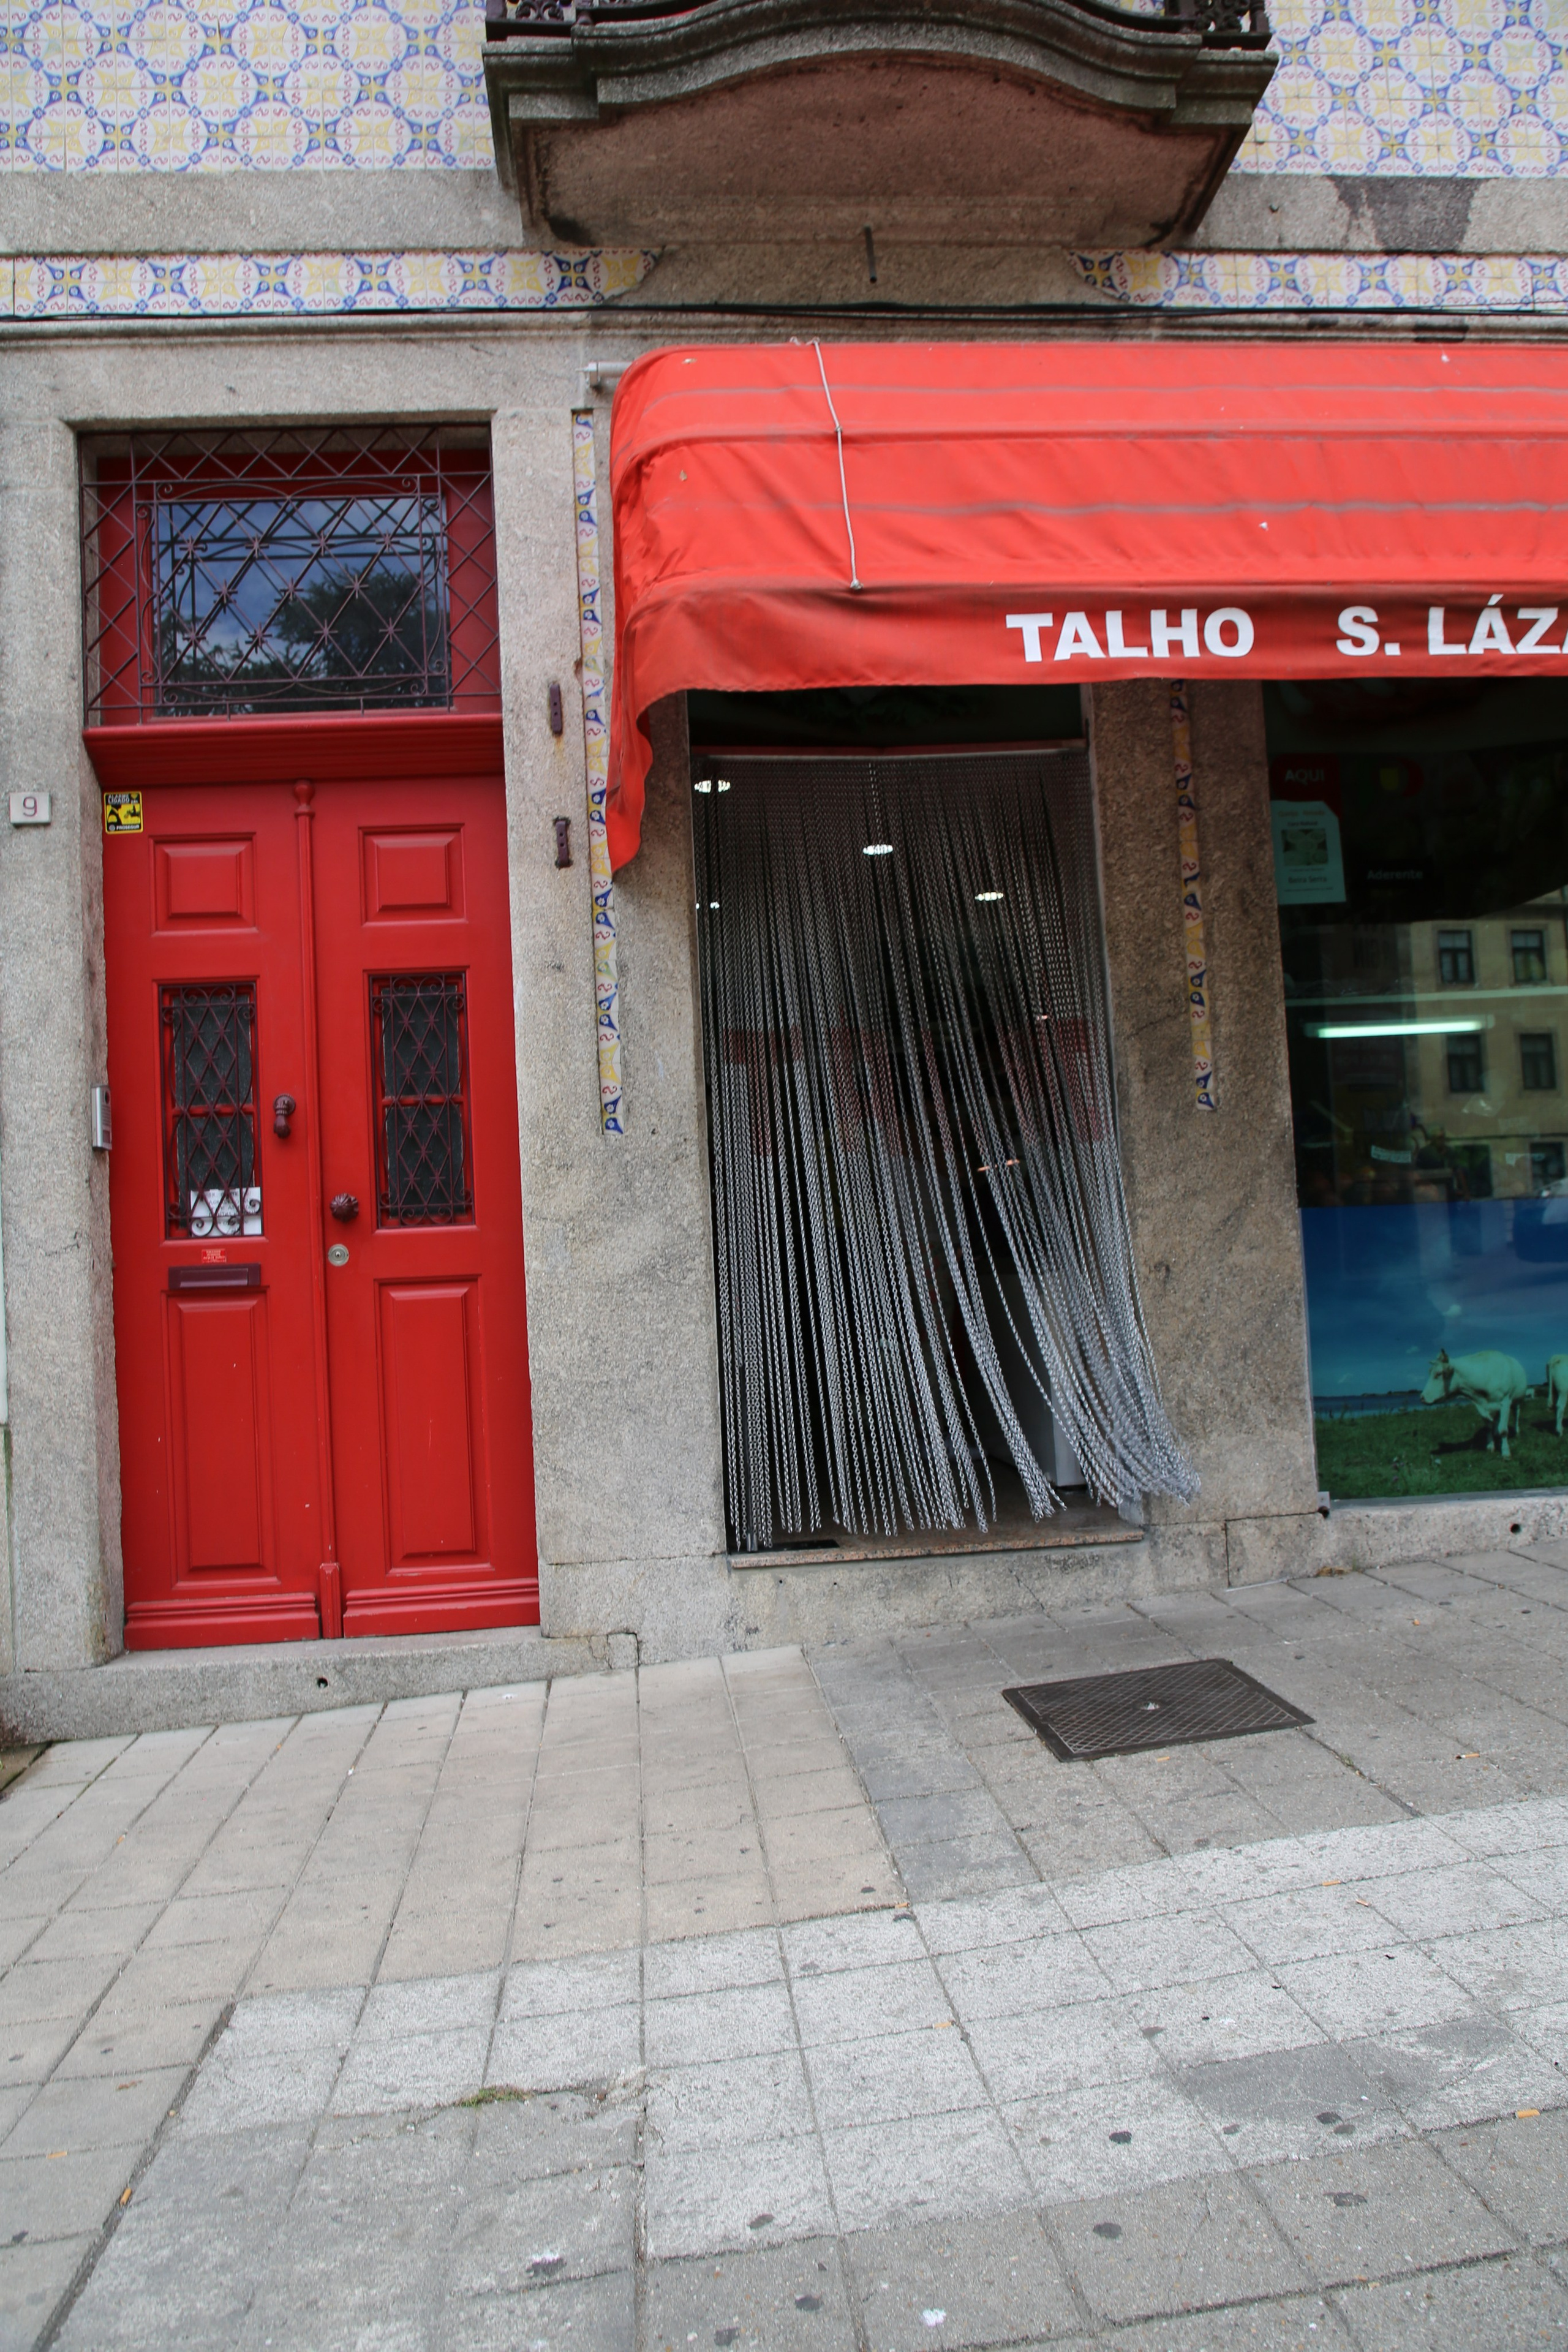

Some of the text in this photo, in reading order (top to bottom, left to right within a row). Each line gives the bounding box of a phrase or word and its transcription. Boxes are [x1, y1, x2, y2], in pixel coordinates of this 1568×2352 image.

[1006, 607, 1254, 662] TALHO
[1336, 606, 1401, 657] S.
[1285, 769, 1325, 786] AQUI
[23, 797, 37, 817] 9
[1366, 869, 1423, 880] Aderente
